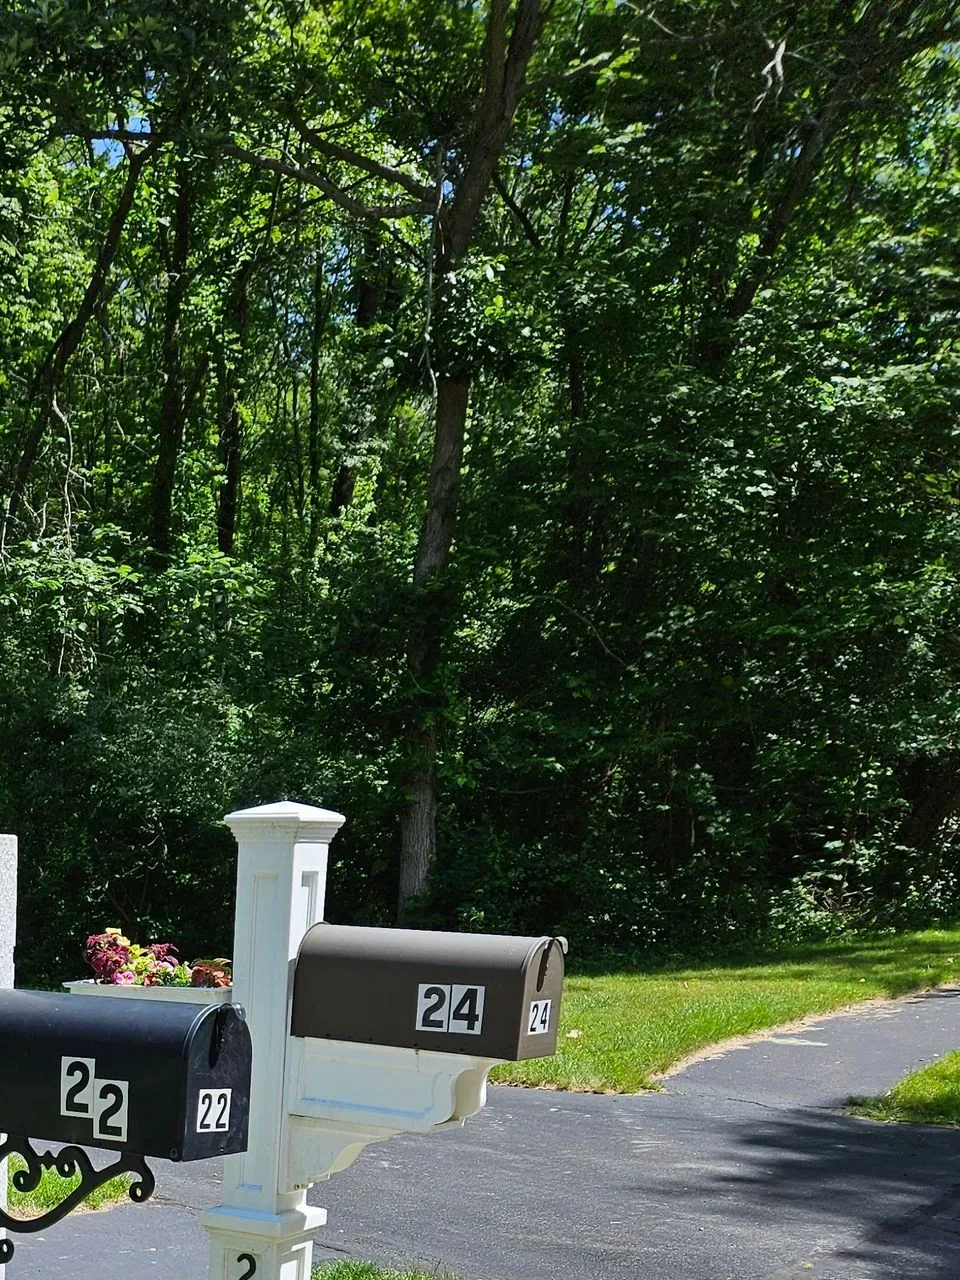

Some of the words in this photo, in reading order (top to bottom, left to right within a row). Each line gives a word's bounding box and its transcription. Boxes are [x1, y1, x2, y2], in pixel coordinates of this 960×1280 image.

[422, 986, 479, 1031] 24
[530, 1002, 549, 1032] 24
[66, 1061, 124, 1137] 22
[199, 1093, 228, 1129] 22
